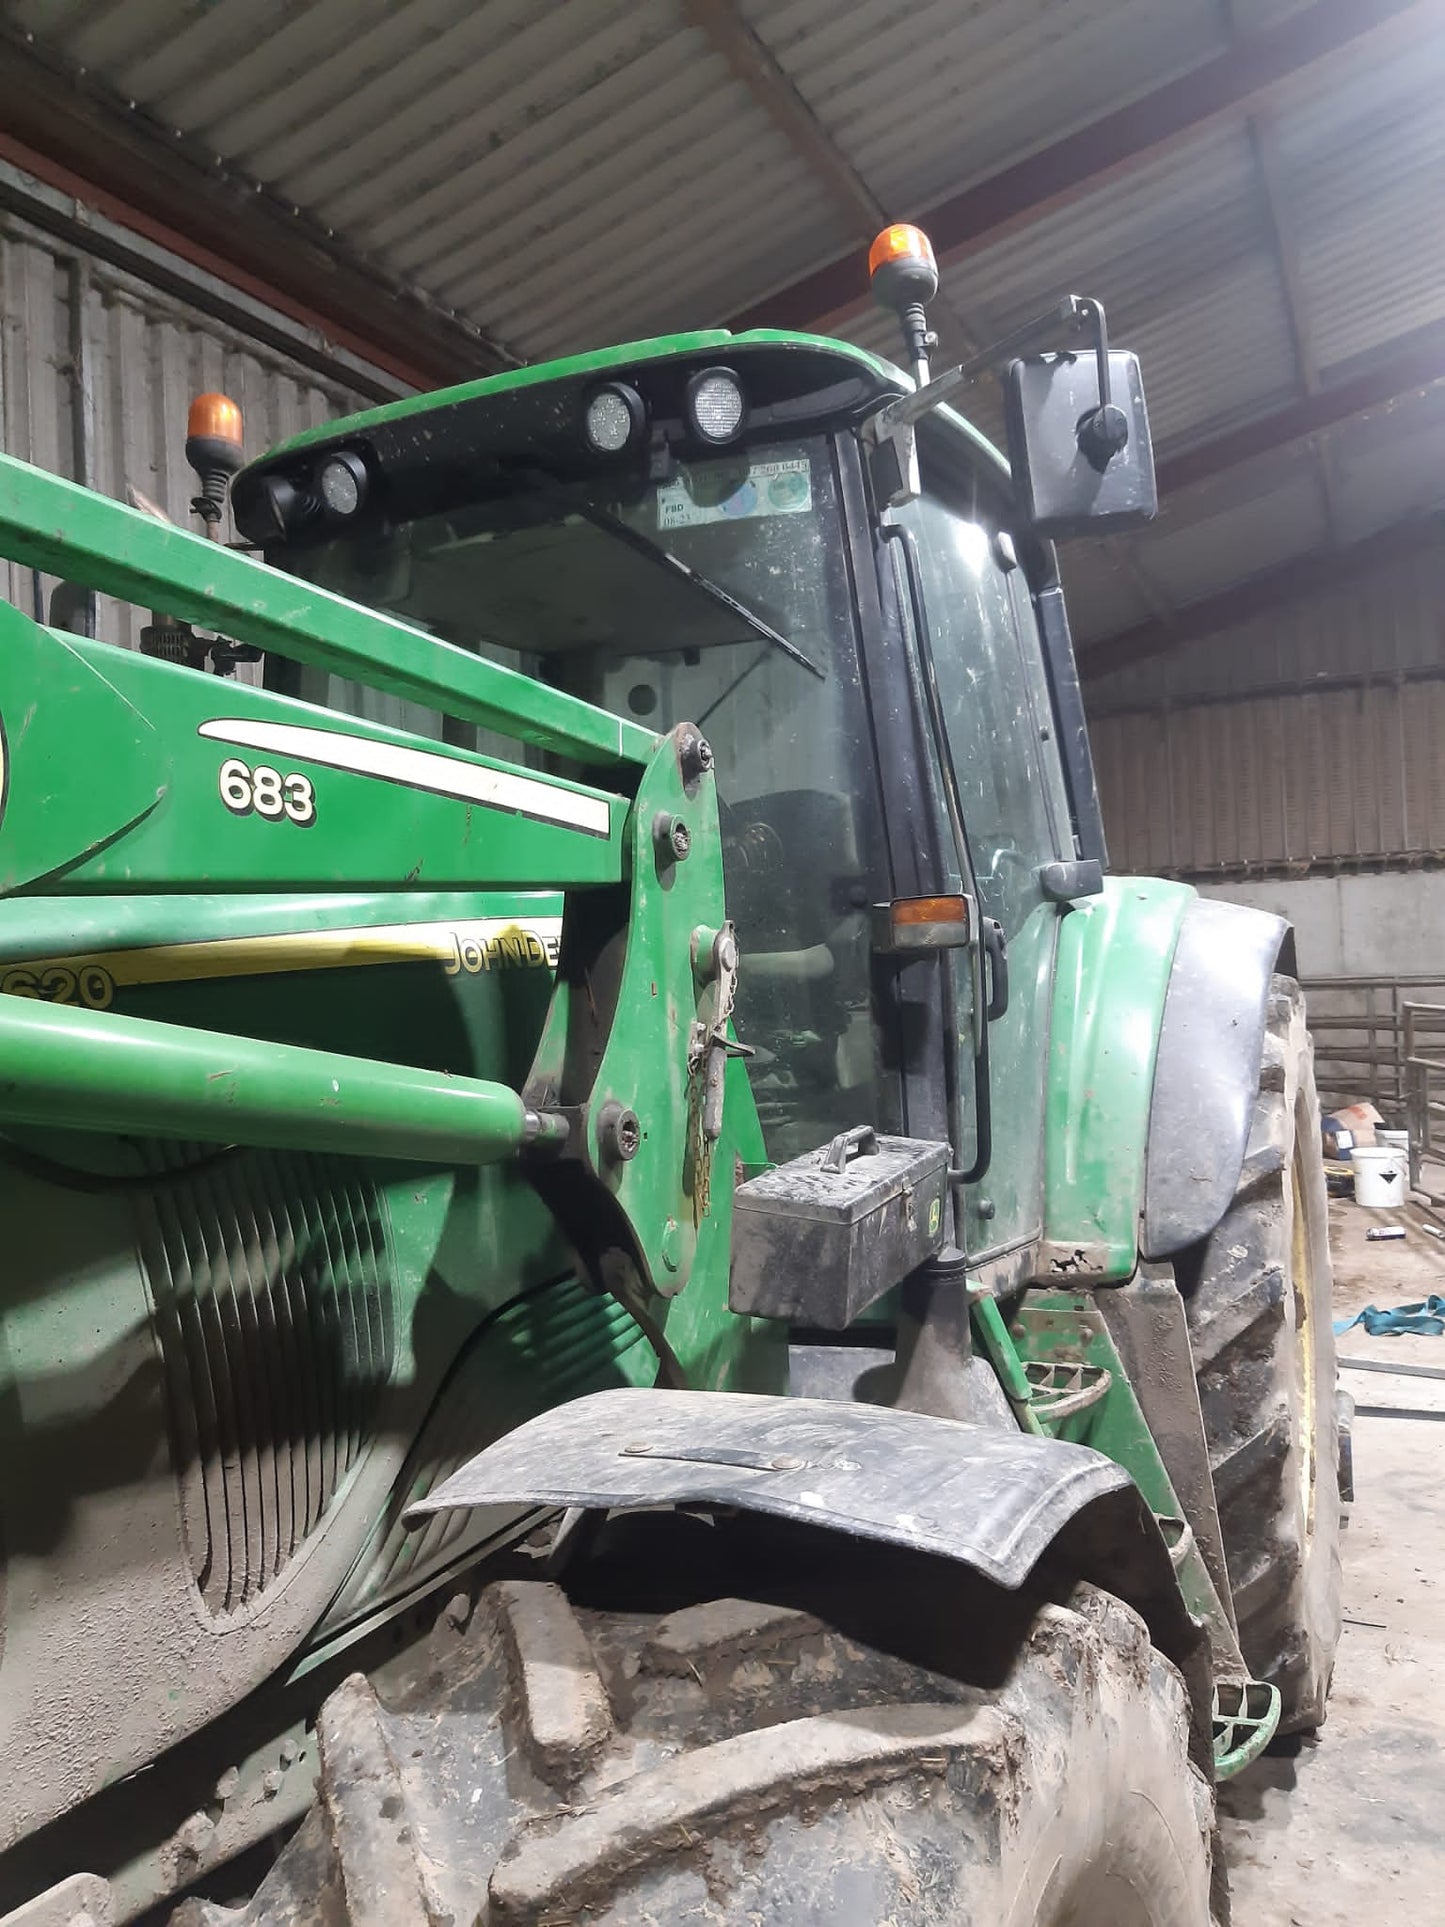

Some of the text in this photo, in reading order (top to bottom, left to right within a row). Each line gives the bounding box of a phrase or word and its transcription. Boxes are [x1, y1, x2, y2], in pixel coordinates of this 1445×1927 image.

[665, 503, 684, 514] FBD
[218, 758, 317, 827] 683
[444, 929, 562, 975] JOHN DE
